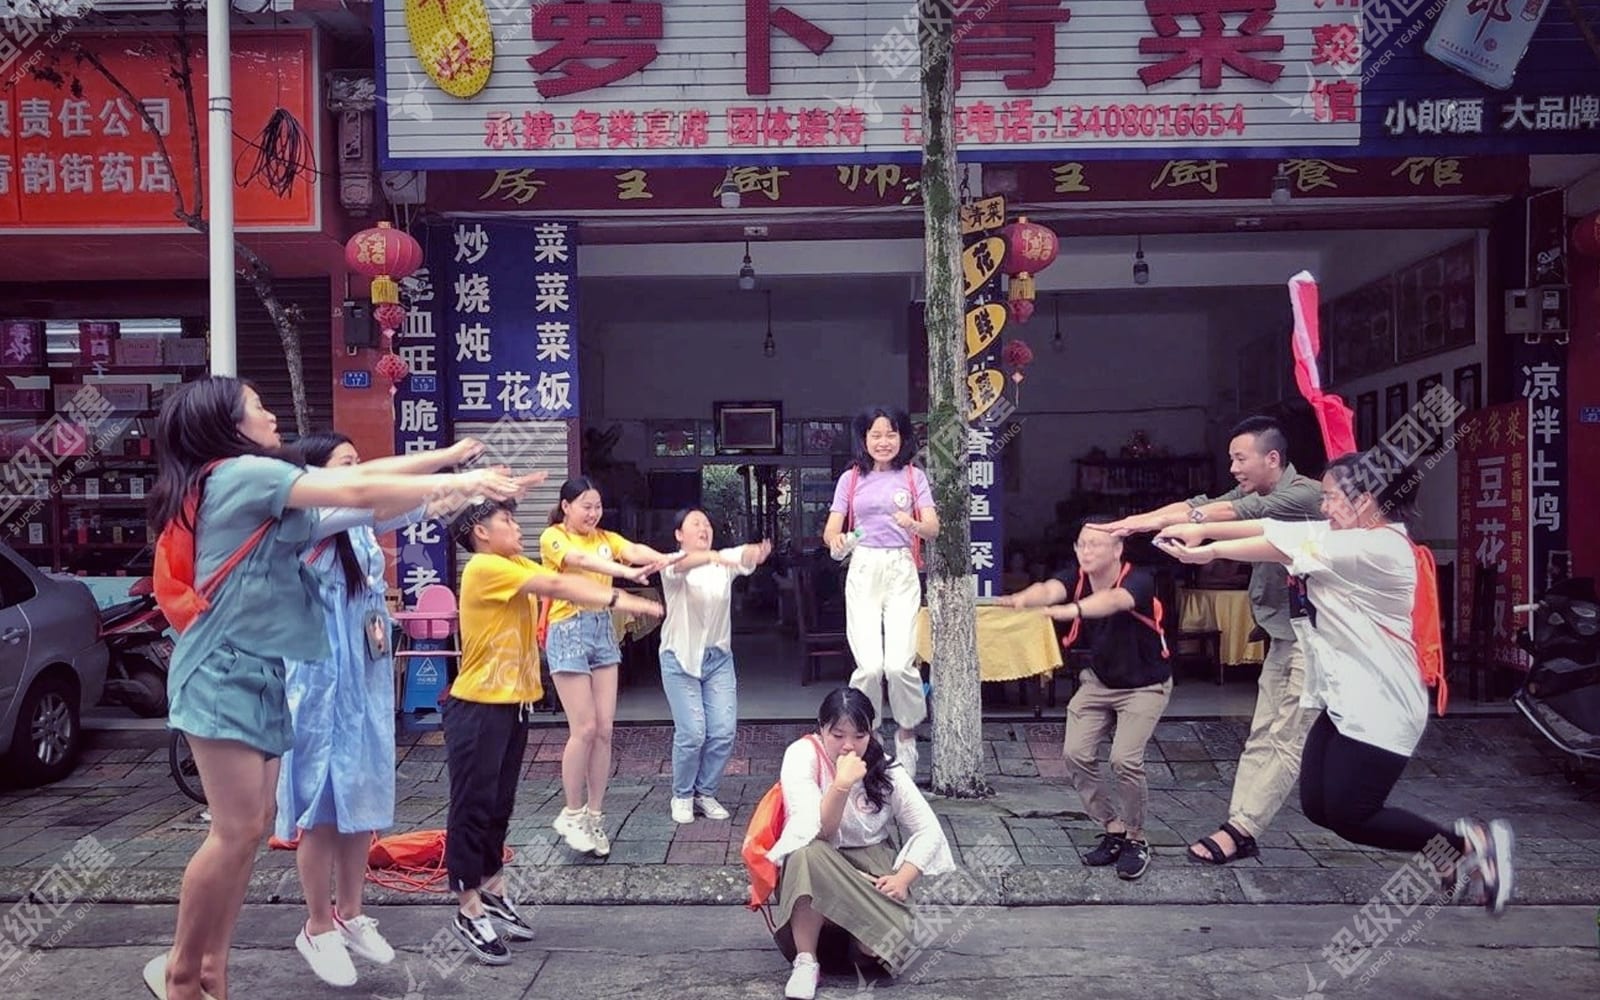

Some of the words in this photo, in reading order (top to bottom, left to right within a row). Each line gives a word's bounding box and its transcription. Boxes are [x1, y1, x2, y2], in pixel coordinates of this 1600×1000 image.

[1311, 0, 1359, 122] 菜馆
[0, 97, 171, 138] 责任公司
[727, 106, 865, 148] 团体接待
[902, 100, 1245, 144] 电话:13408016654
[1385, 98, 1484, 134] 小郎酒
[1503, 96, 1600, 131] 大品牌
[962, 201, 1002, 229] 青菜
[457, 371, 573, 411] 豆花饭
[1521, 362, 1561, 532] 凉拌土鸡
